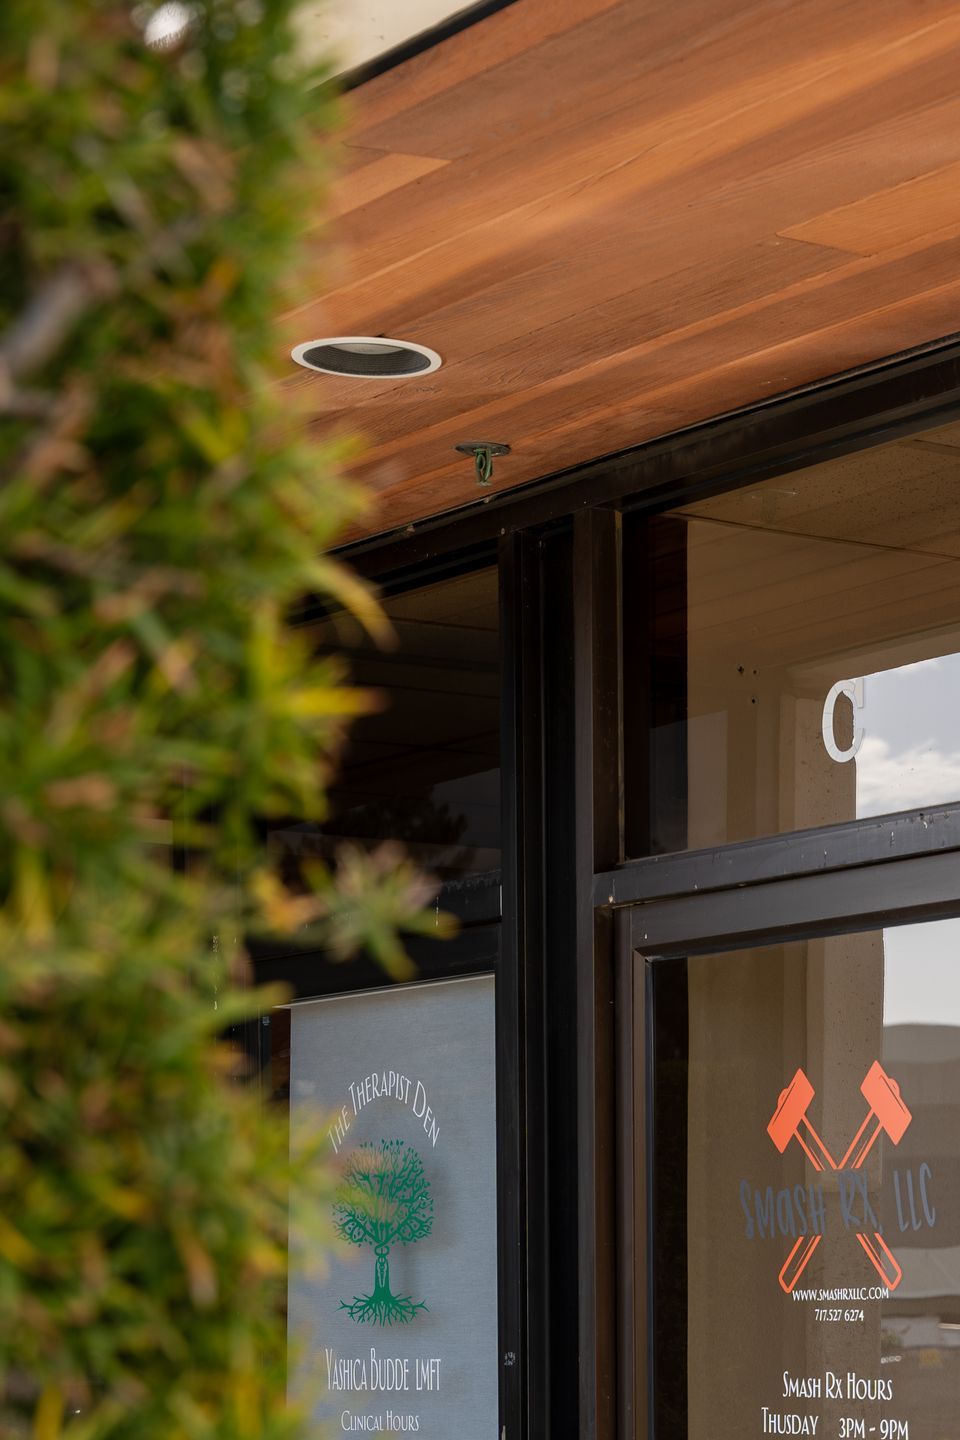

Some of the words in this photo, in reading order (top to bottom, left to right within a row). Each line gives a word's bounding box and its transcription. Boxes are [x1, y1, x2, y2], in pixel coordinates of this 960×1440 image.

[822, 678, 864, 763] C
[327, 1105, 350, 1154] THE
[348, 1070, 412, 1116] THERAPIST
[412, 1080, 440, 1148] DEN
[893, 1162, 936, 1232] LLC
[792, 1286, 889, 1301] WWW.SMASHRXLLC.COM
[844, 1309, 864, 1321] 6274
[325, 1348, 368, 1391] YASHICA
[370, 1347, 409, 1391] BUDDE
[415, 1358, 441, 1391] LMFT
[782, 1370, 821, 1399] SMASH
[846, 1372, 893, 1401] HOURS
[341, 1410, 384, 1431] CLINICAL
[386, 1410, 419, 1431] HOURS
[838, 1417, 866, 1439] 3PM
[880, 1419, 909, 1440] 9PM
